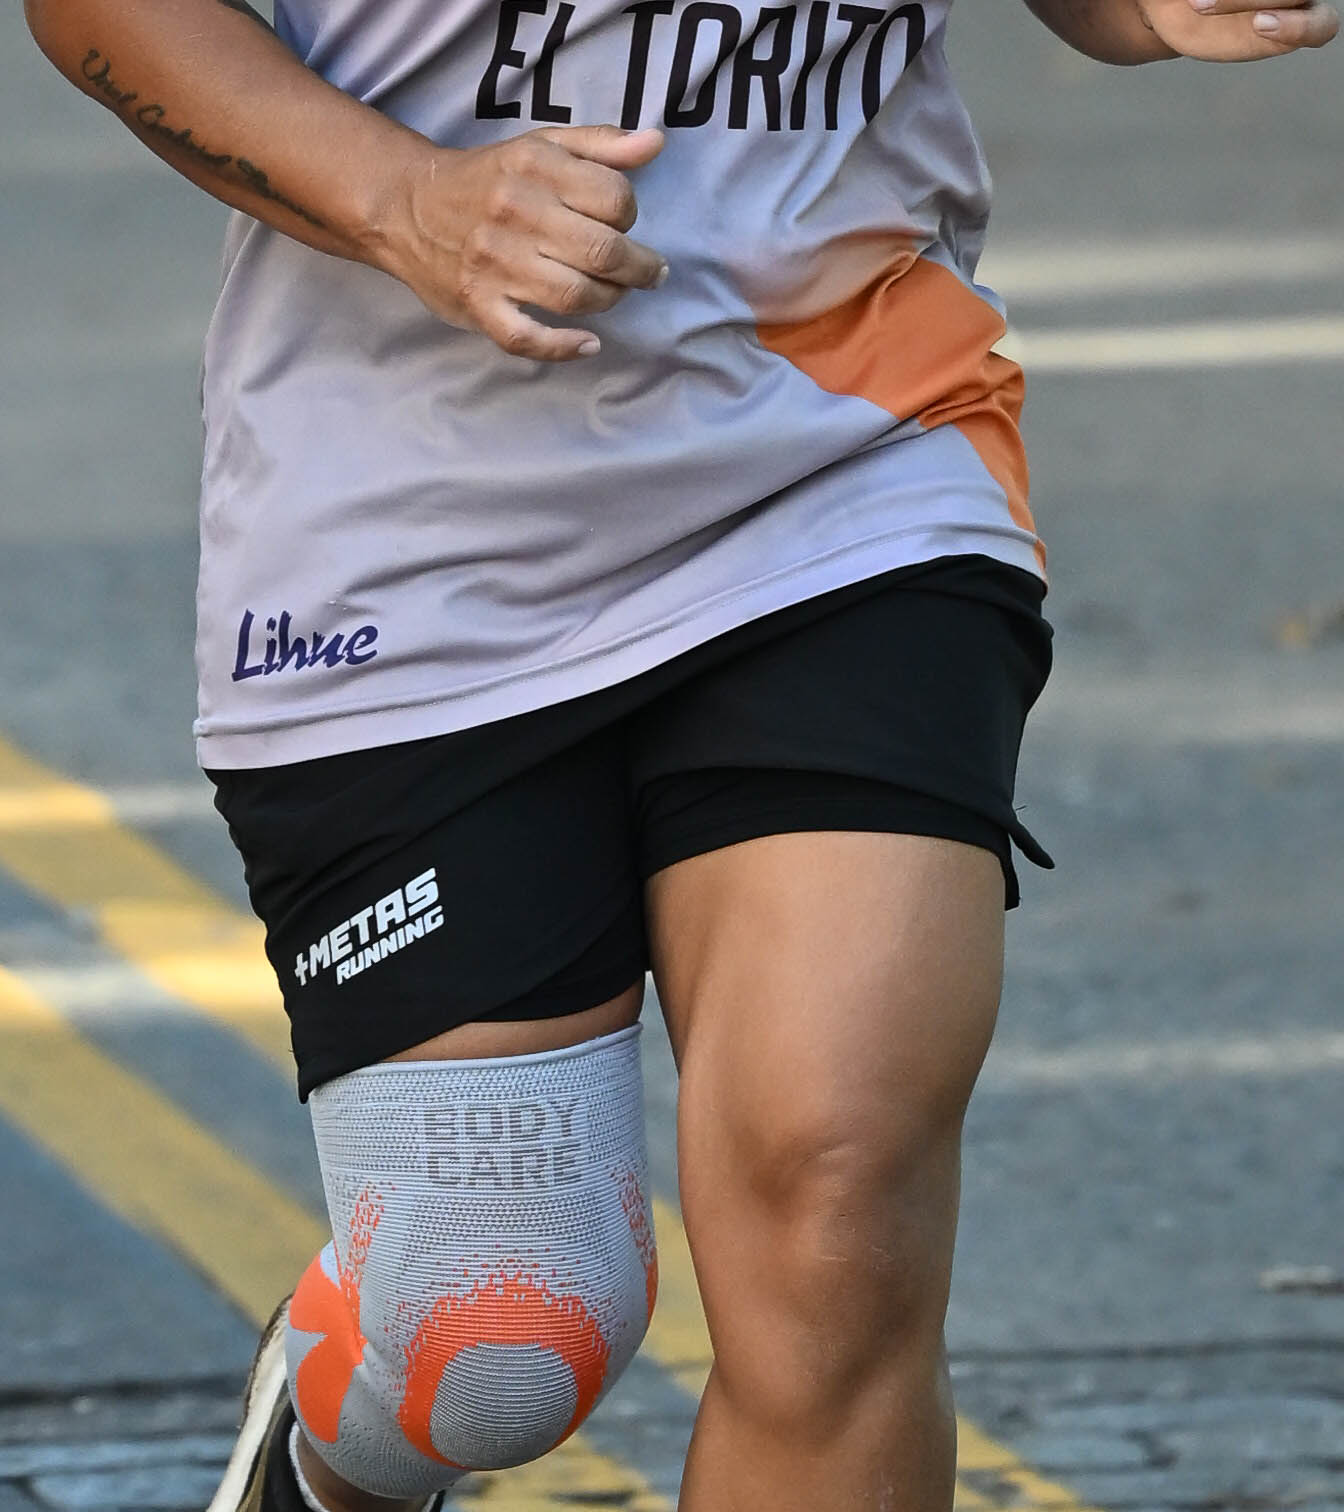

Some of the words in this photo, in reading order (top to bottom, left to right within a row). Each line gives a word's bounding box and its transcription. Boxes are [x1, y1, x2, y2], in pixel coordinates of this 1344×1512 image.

[620, 0, 926, 132] TORITO
[231, 608, 379, 682] Lihue
[336, 905, 445, 985] RUNNING
[423, 1097, 581, 1144] BODY
[426, 1143, 582, 1190] CARE
